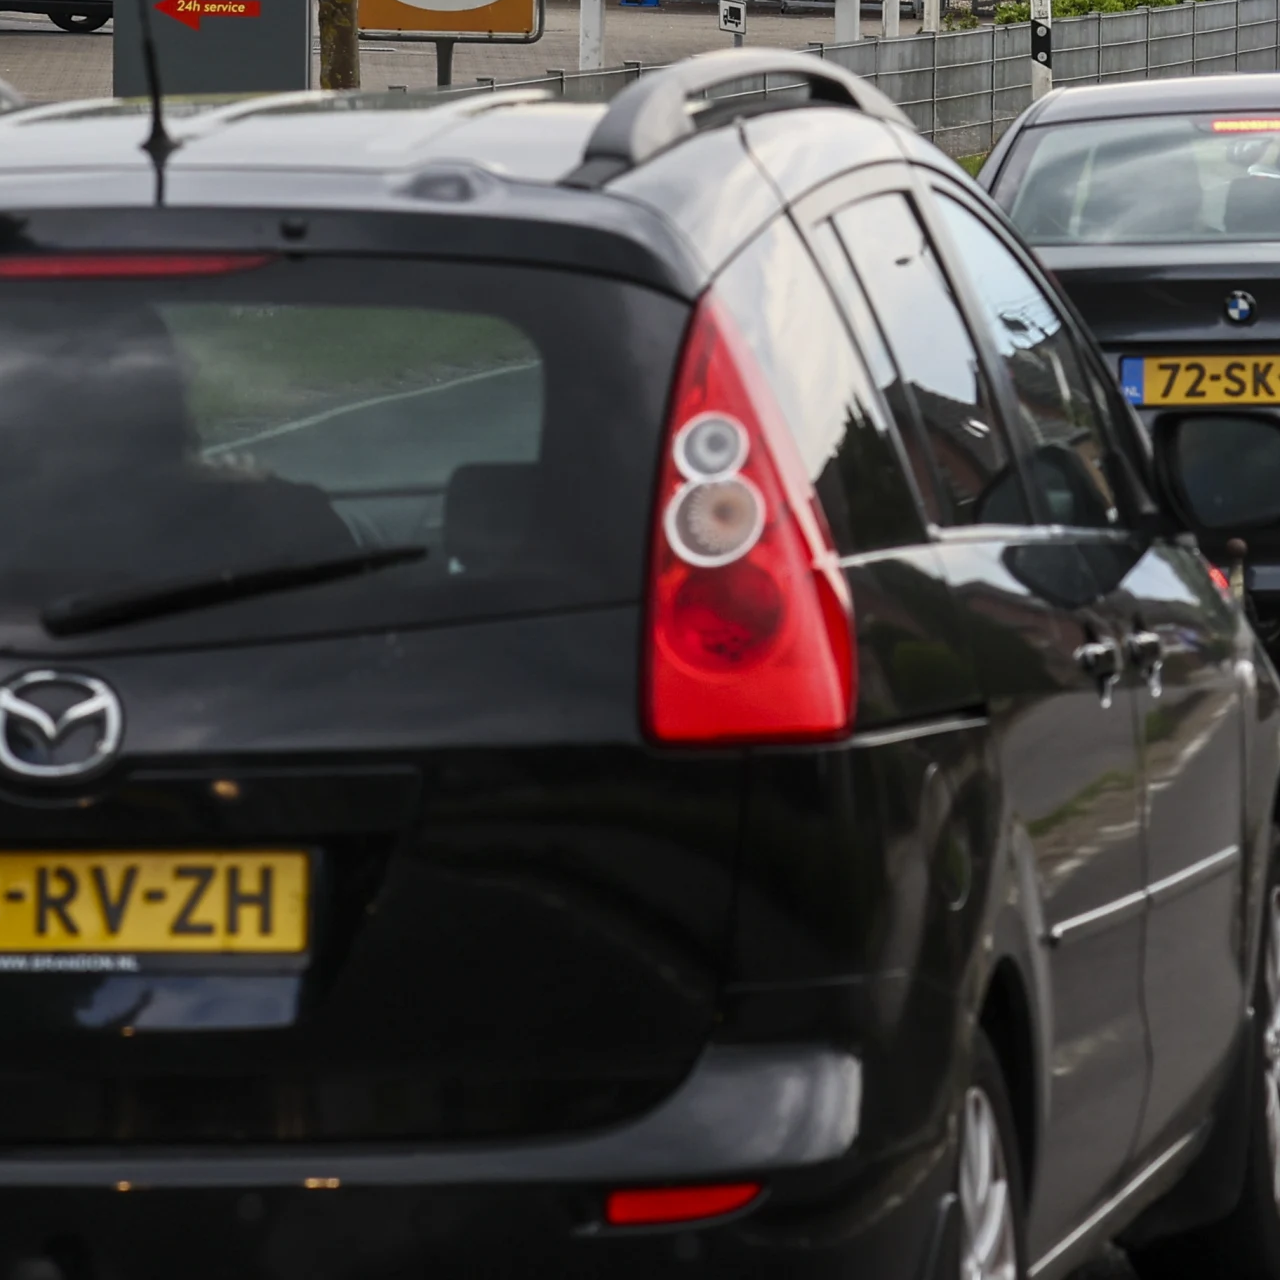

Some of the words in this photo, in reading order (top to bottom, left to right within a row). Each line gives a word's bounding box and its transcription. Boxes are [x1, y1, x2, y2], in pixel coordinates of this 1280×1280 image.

[176, 0, 201, 13] 24h
[203, 2, 246, 13] service
[1125, 386, 1141, 398] NL
